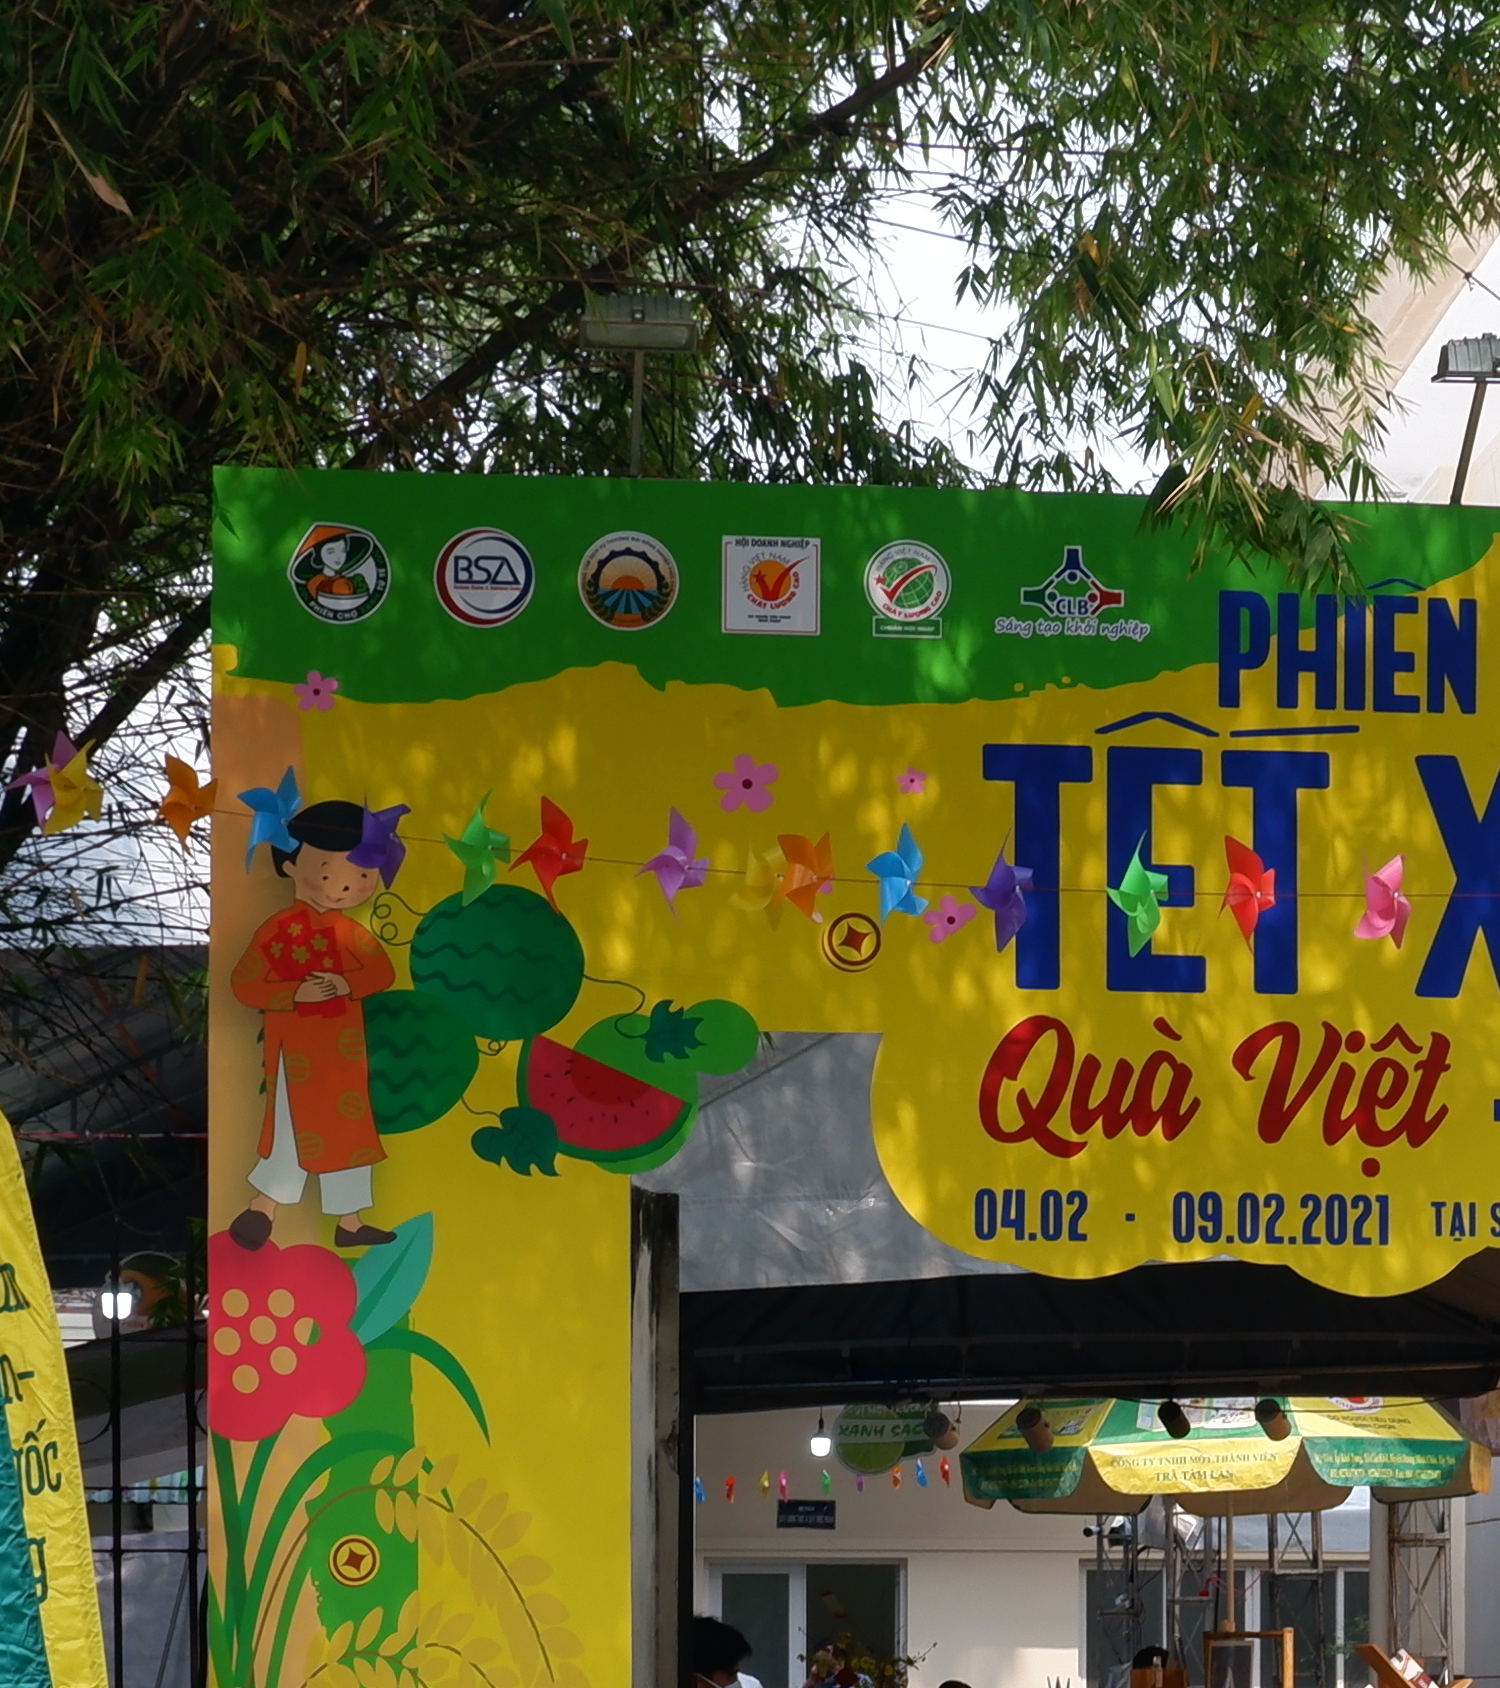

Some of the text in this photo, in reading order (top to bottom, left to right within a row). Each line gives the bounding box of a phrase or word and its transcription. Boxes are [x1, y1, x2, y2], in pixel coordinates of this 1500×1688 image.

[453, 555, 521, 585] BSA
[996, 617, 1150, 641] Sáng tạo khởi nghiệp
[1056, 598, 1090, 616] CLB
[1218, 579, 1477, 714] PHIÊN
[982, 710, 1359, 994] TẾT
[979, 1015, 1200, 1158] Quà
[1233, 1021, 1451, 1177] Việt
[974, 1188, 1088, 1242] 04.02
[1173, 1191, 1389, 1245] 09.02.2021
[1430, 1202, 1477, 1244] TẠI
